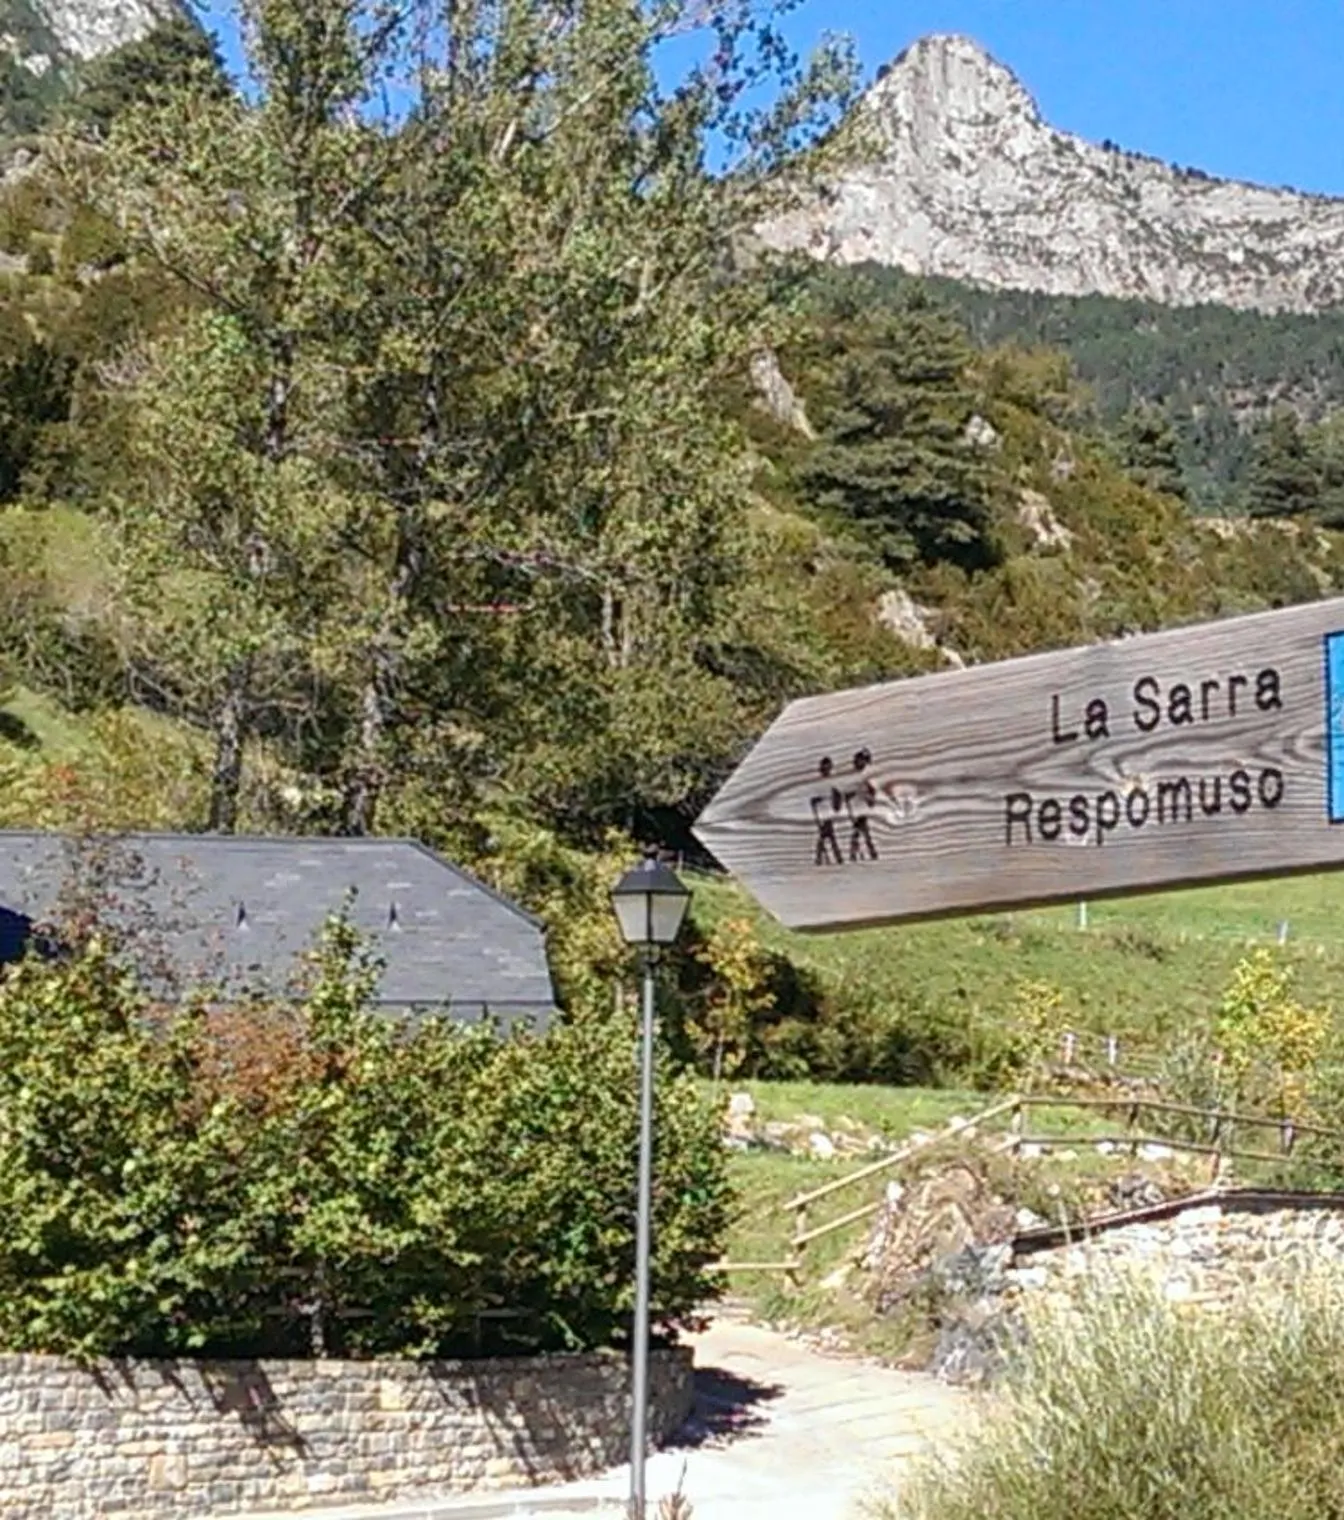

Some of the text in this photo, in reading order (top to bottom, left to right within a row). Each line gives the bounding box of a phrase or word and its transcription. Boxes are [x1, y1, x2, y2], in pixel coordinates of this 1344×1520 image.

[1051, 666, 1284, 744] La Sarra
[1005, 765, 1286, 847] Respomuso
